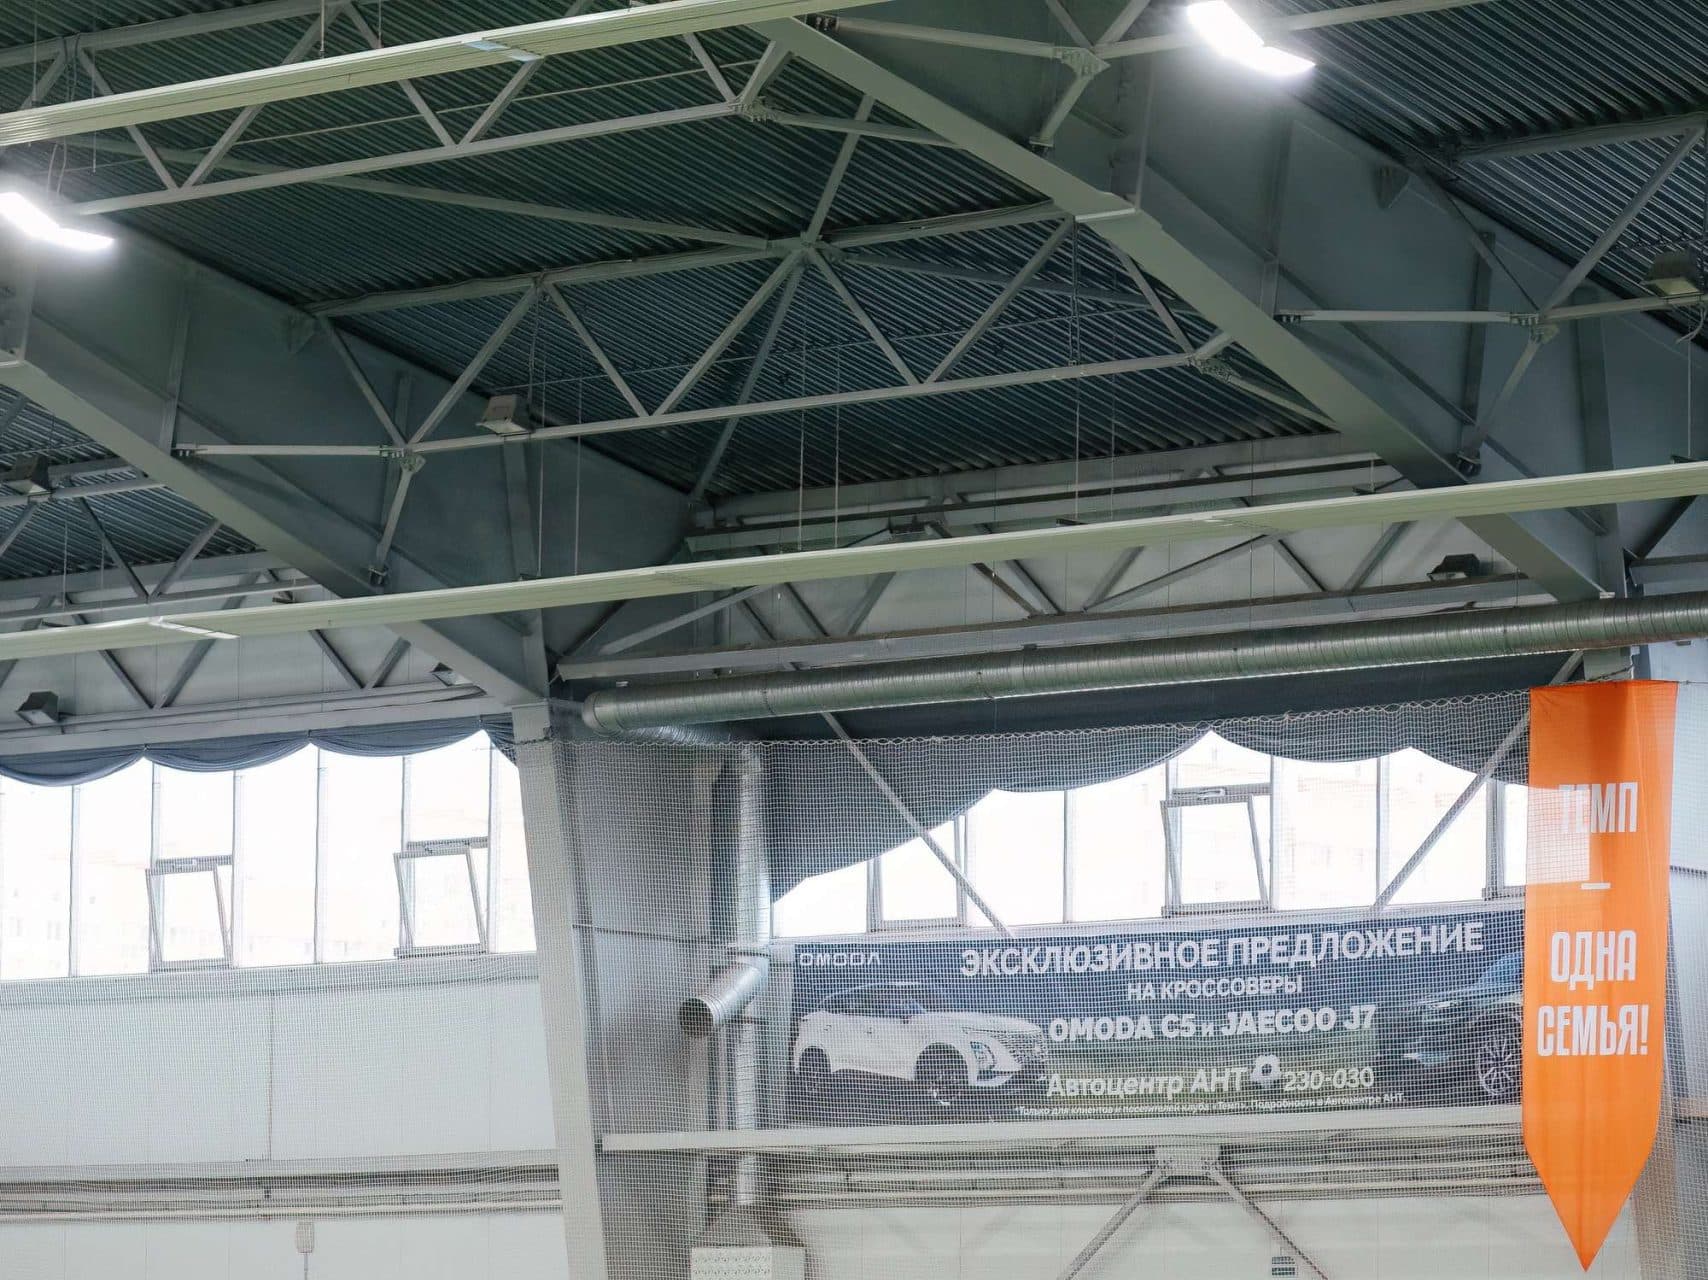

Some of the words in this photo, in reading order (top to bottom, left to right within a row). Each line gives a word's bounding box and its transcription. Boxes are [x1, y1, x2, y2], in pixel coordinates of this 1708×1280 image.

[1559, 782, 1638, 833] ТЕМП
[960, 939, 1219, 977] ЭКСКЛЮЗИВНОЕ
[1227, 922, 1484, 967] ПРЕДЛОЖЕНИЕ
[1551, 930, 1637, 990] ОДНА
[1127, 981, 1156, 1001] НА
[1163, 974, 1303, 1000] КРОССОВЕРЫ
[1049, 1014, 1155, 1042] OMODA
[1162, 1013, 1196, 1038] C5
[1222, 1007, 1337, 1038] JAECOO
[1344, 1005, 1376, 1031] J7
[1537, 1004, 1649, 1057] СЕМЬЯ!
[1046, 1073, 1183, 1100] Автоцентр
[1190, 1067, 1249, 1093] АНТ
[1283, 1066, 1375, 1092] 230-030
